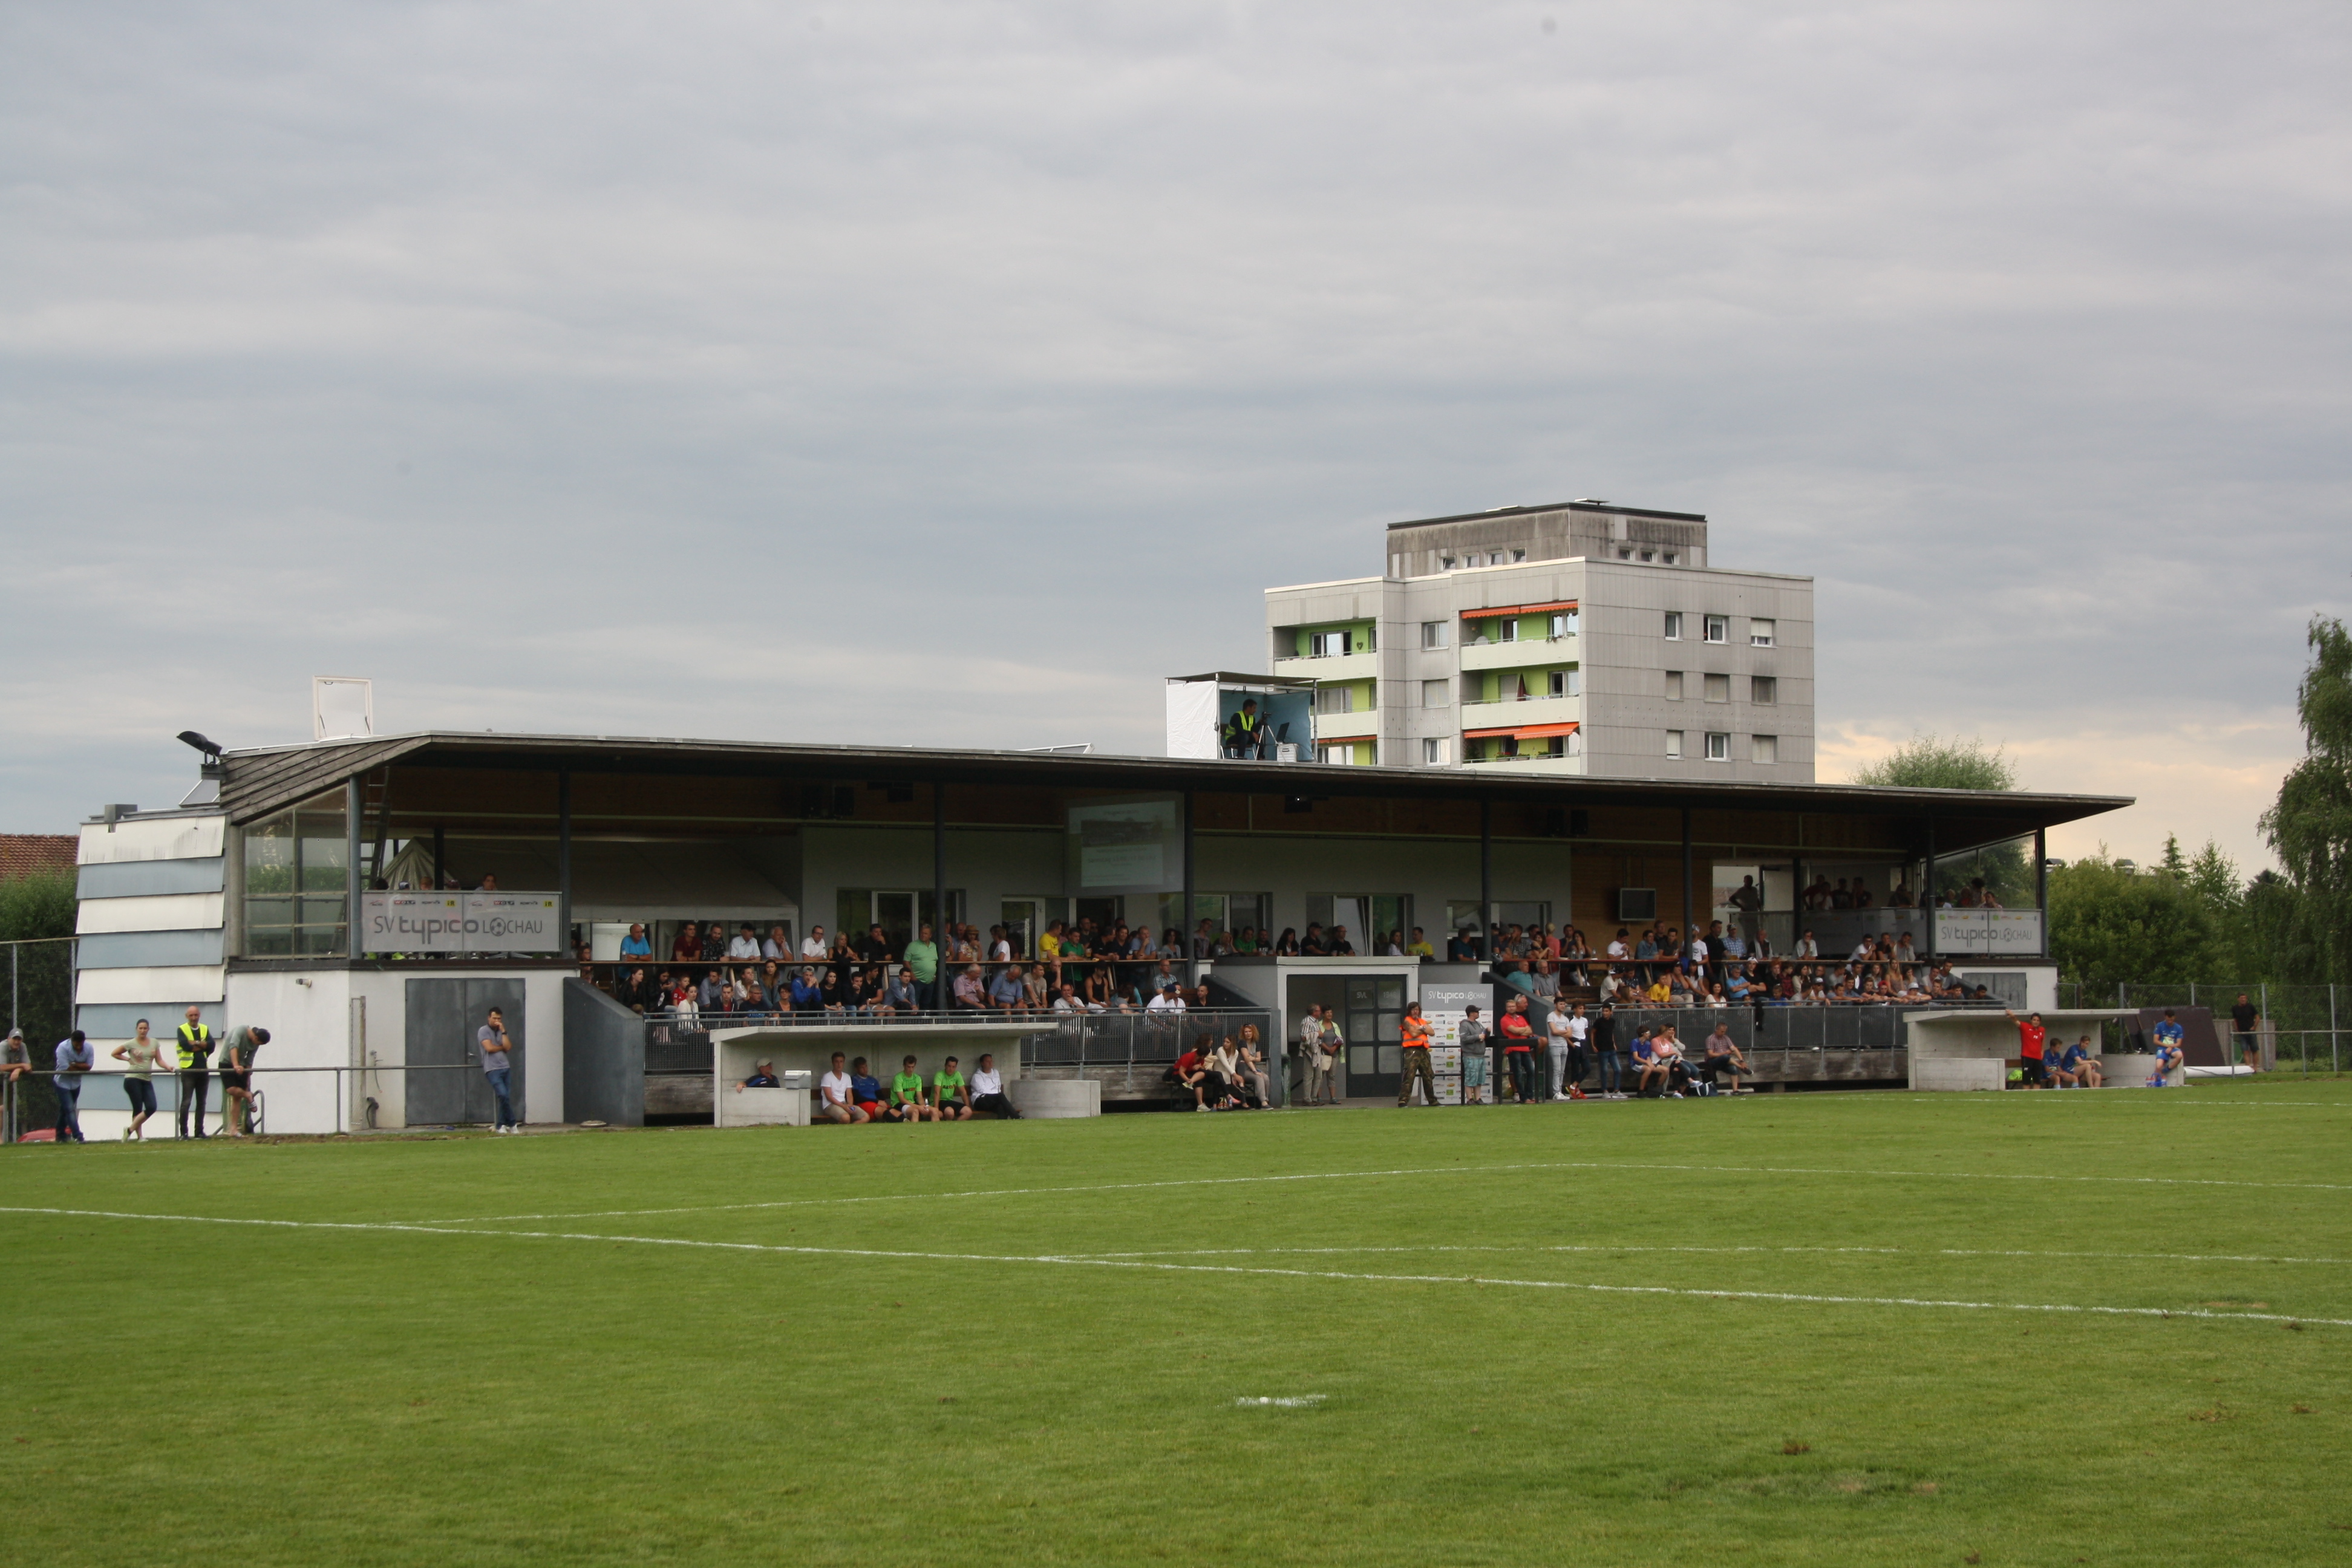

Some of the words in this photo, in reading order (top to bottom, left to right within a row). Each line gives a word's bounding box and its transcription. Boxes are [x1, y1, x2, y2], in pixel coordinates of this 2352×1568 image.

[374, 916, 396, 933] SV
[399, 916, 479, 944] typico
[1941, 926, 1953, 939] SV
[1955, 927, 1998, 947] typico
[1437, 991, 1465, 1004] typico
